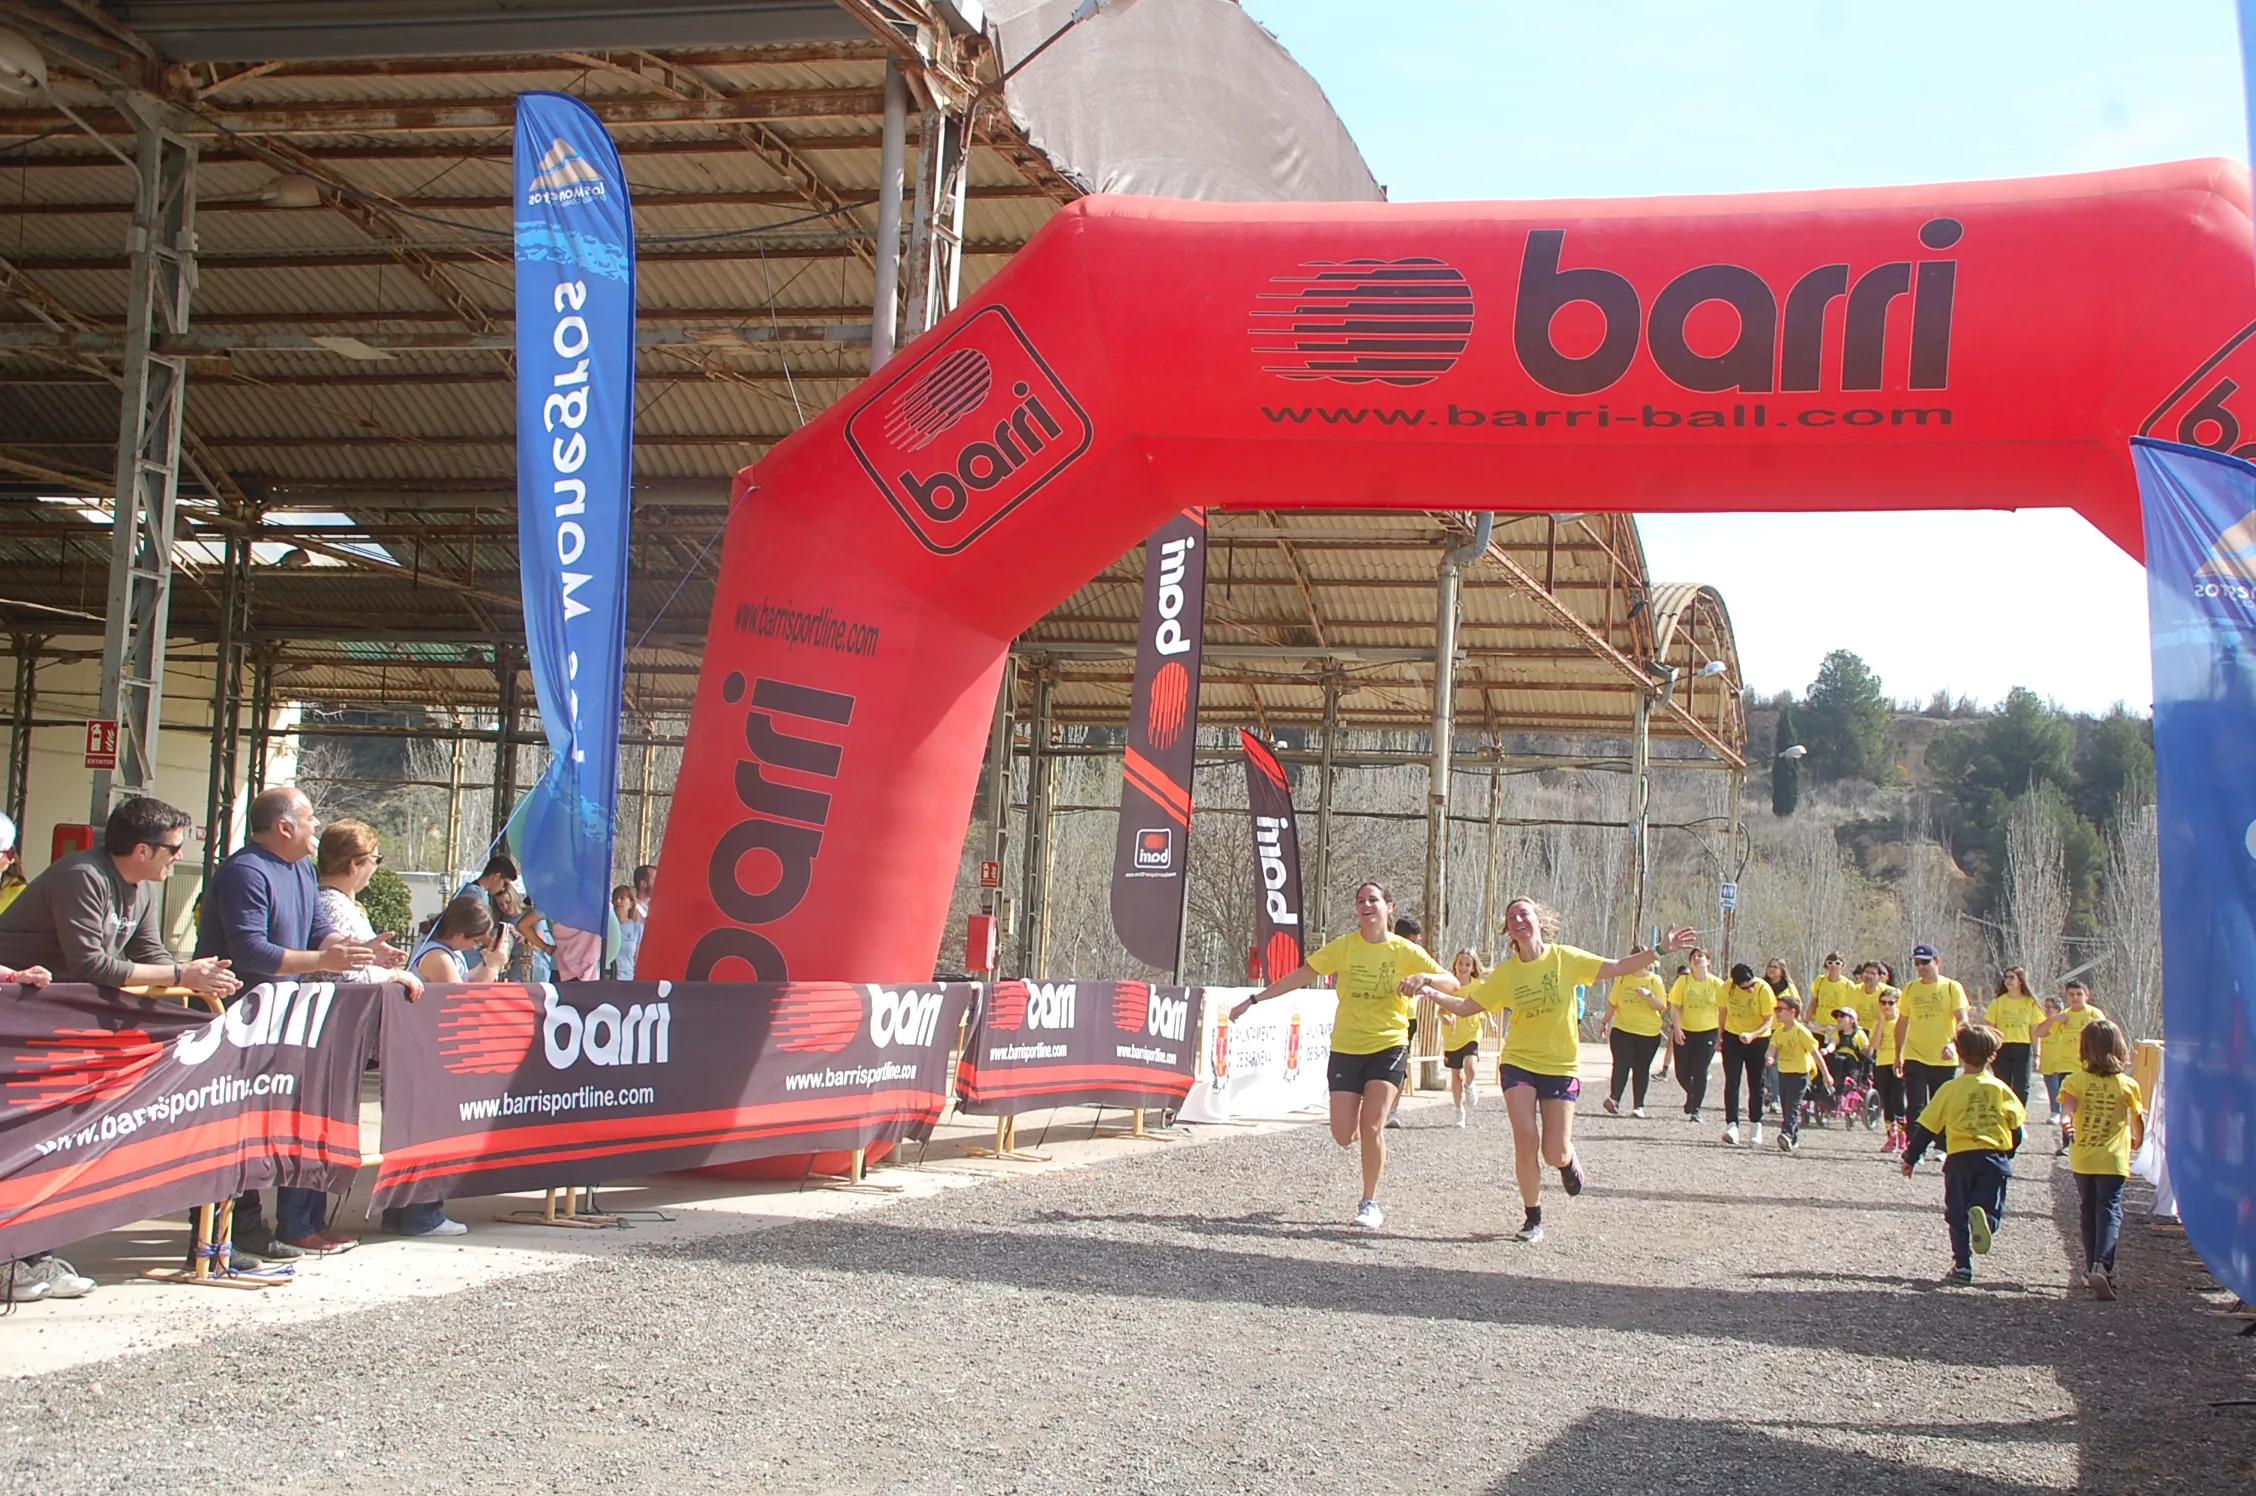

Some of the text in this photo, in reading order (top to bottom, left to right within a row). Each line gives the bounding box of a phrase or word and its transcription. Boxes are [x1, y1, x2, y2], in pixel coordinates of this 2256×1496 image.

[1513, 217, 1963, 396] barri
[1260, 404, 1953, 428] www.barri-ball.com
[897, 380, 1062, 523] barri
[734, 595, 879, 659] www.barrisportline.com
[540, 980, 672, 1069] barri
[865, 982, 948, 1048] barri
[1020, 977, 1077, 1030] barri
[1148, 983, 1190, 1042] barri
[459, 1085, 654, 1122] www.barrisportline.com
